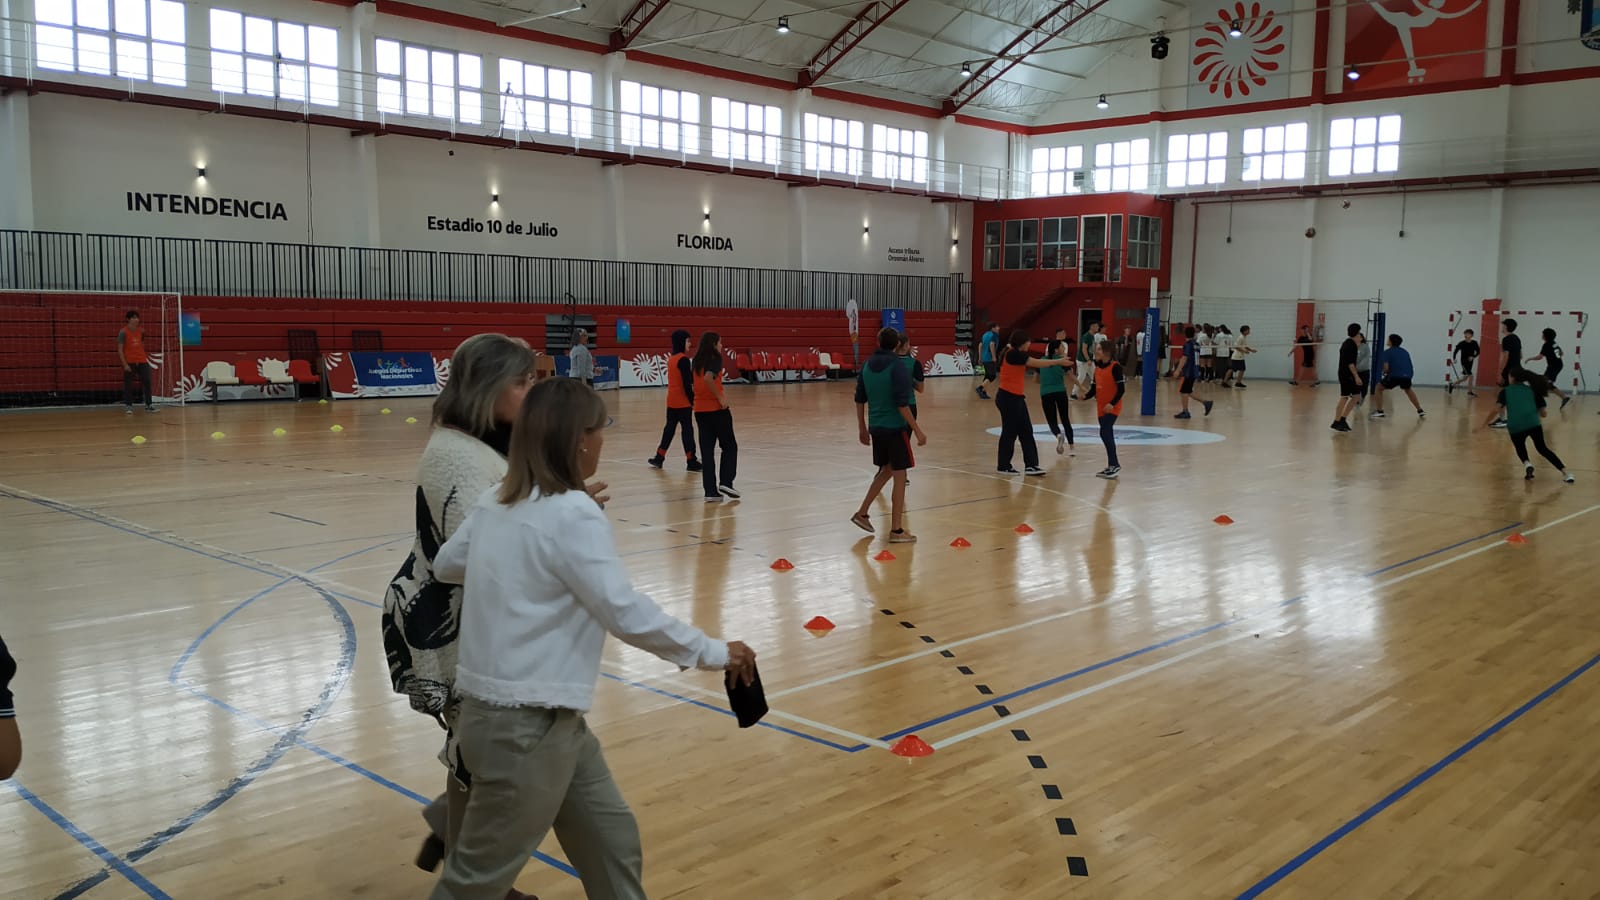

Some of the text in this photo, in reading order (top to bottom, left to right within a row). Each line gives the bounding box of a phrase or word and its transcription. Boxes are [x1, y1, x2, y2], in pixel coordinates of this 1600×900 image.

[126, 191, 288, 221] INTENDENCIA
[427, 216, 558, 238] Estadio 10 de Julio
[677, 233, 733, 252] FLORIDA
